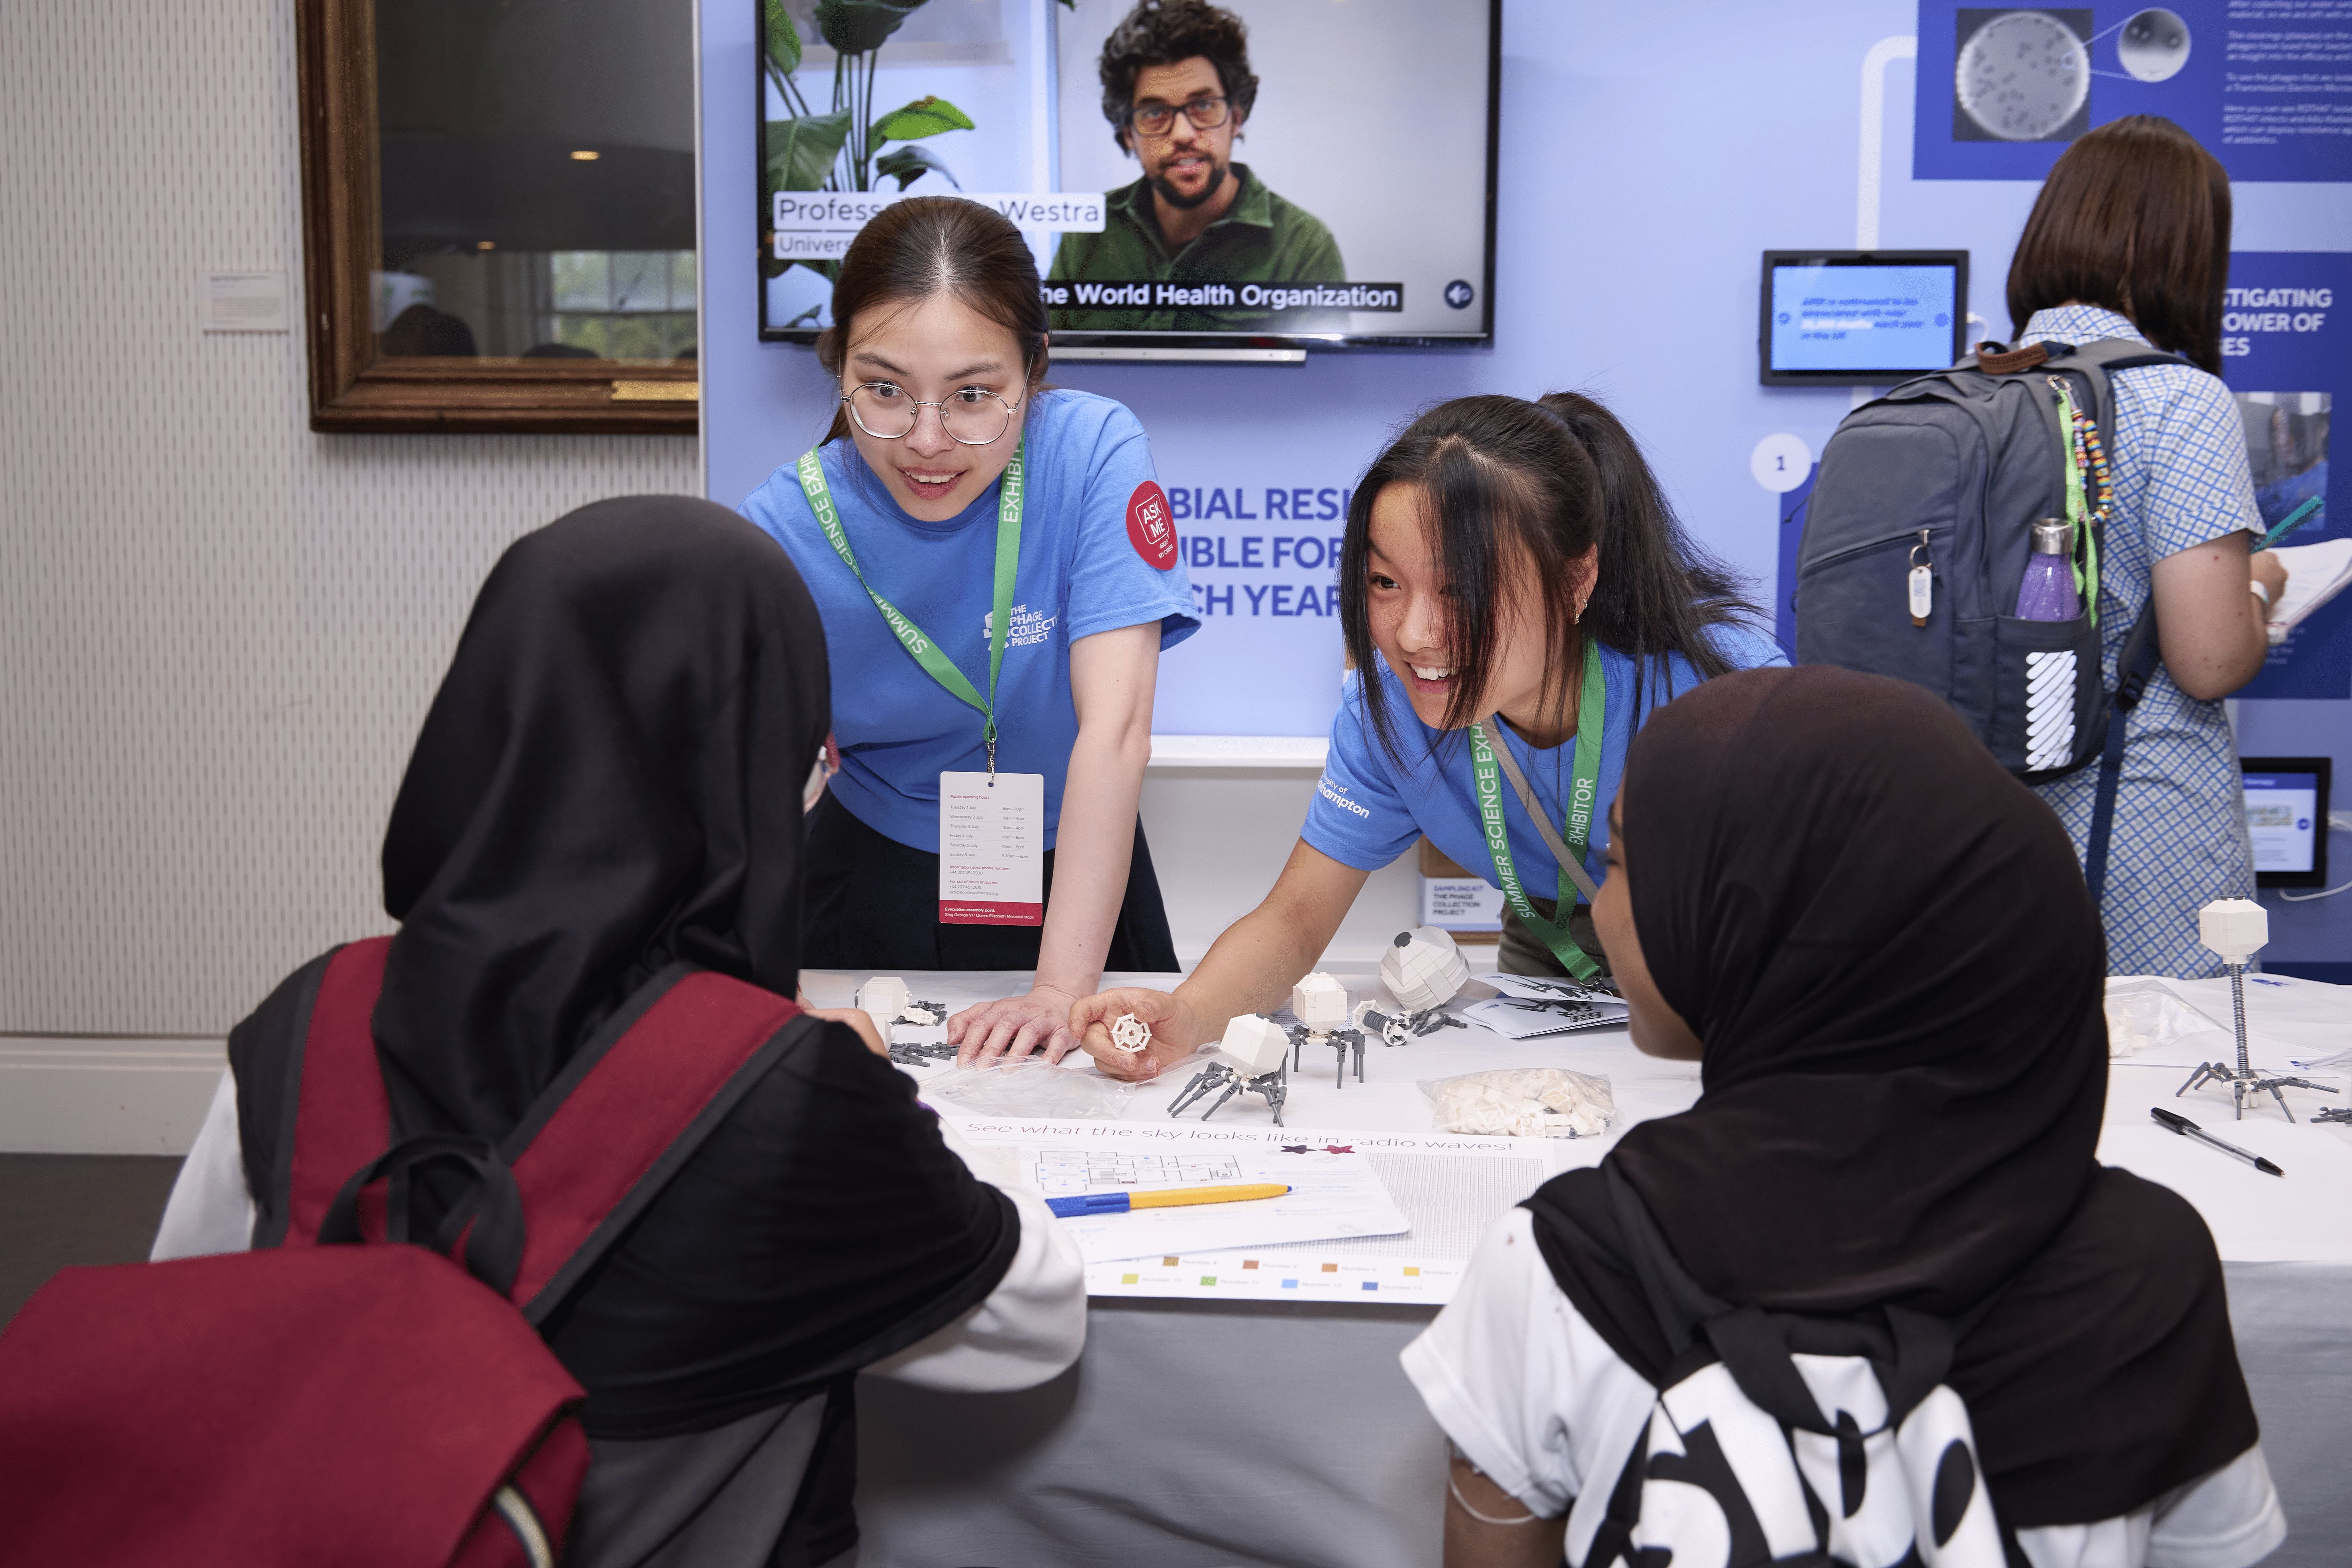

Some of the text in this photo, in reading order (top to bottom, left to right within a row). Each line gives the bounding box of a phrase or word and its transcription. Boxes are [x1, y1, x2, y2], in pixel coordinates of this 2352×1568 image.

[999, 201, 1098, 221] Westra
[1074, 284, 1150, 305] World
[1155, 284, 1235, 306] Health
[1240, 284, 1398, 310] Organization
[2292, 312, 2326, 332] OF
[1776, 456, 1785, 471] 1
[1143, 500, 1161, 524] ASK
[814, 497, 859, 576] SCIENCE
[1150, 517, 1165, 538] ME
[1160, 538, 1169, 549] ABOUT
[1164, 544, 1174, 555] CAREER
[1009, 610, 1043, 626] PHAGE
[1011, 604, 1027, 616] THE
[1012, 631, 1049, 647] PROJECT
[1479, 767, 1506, 850] SCIENCE
[1568, 777, 1593, 846] EXHIBITOR
[1496, 854, 1536, 919] SUMMER
[966, 1123, 1012, 1133] See
[1021, 1125, 1084, 1135] what
[1092, 1127, 1132, 1137] the
[1141, 1129, 1183, 1140] sky
[1190, 1131, 1257, 1141] looks
[1267, 1134, 1308, 1143] like
[1318, 1136, 1339, 1144] in
[1425, 1141, 1512, 1151] waves!
